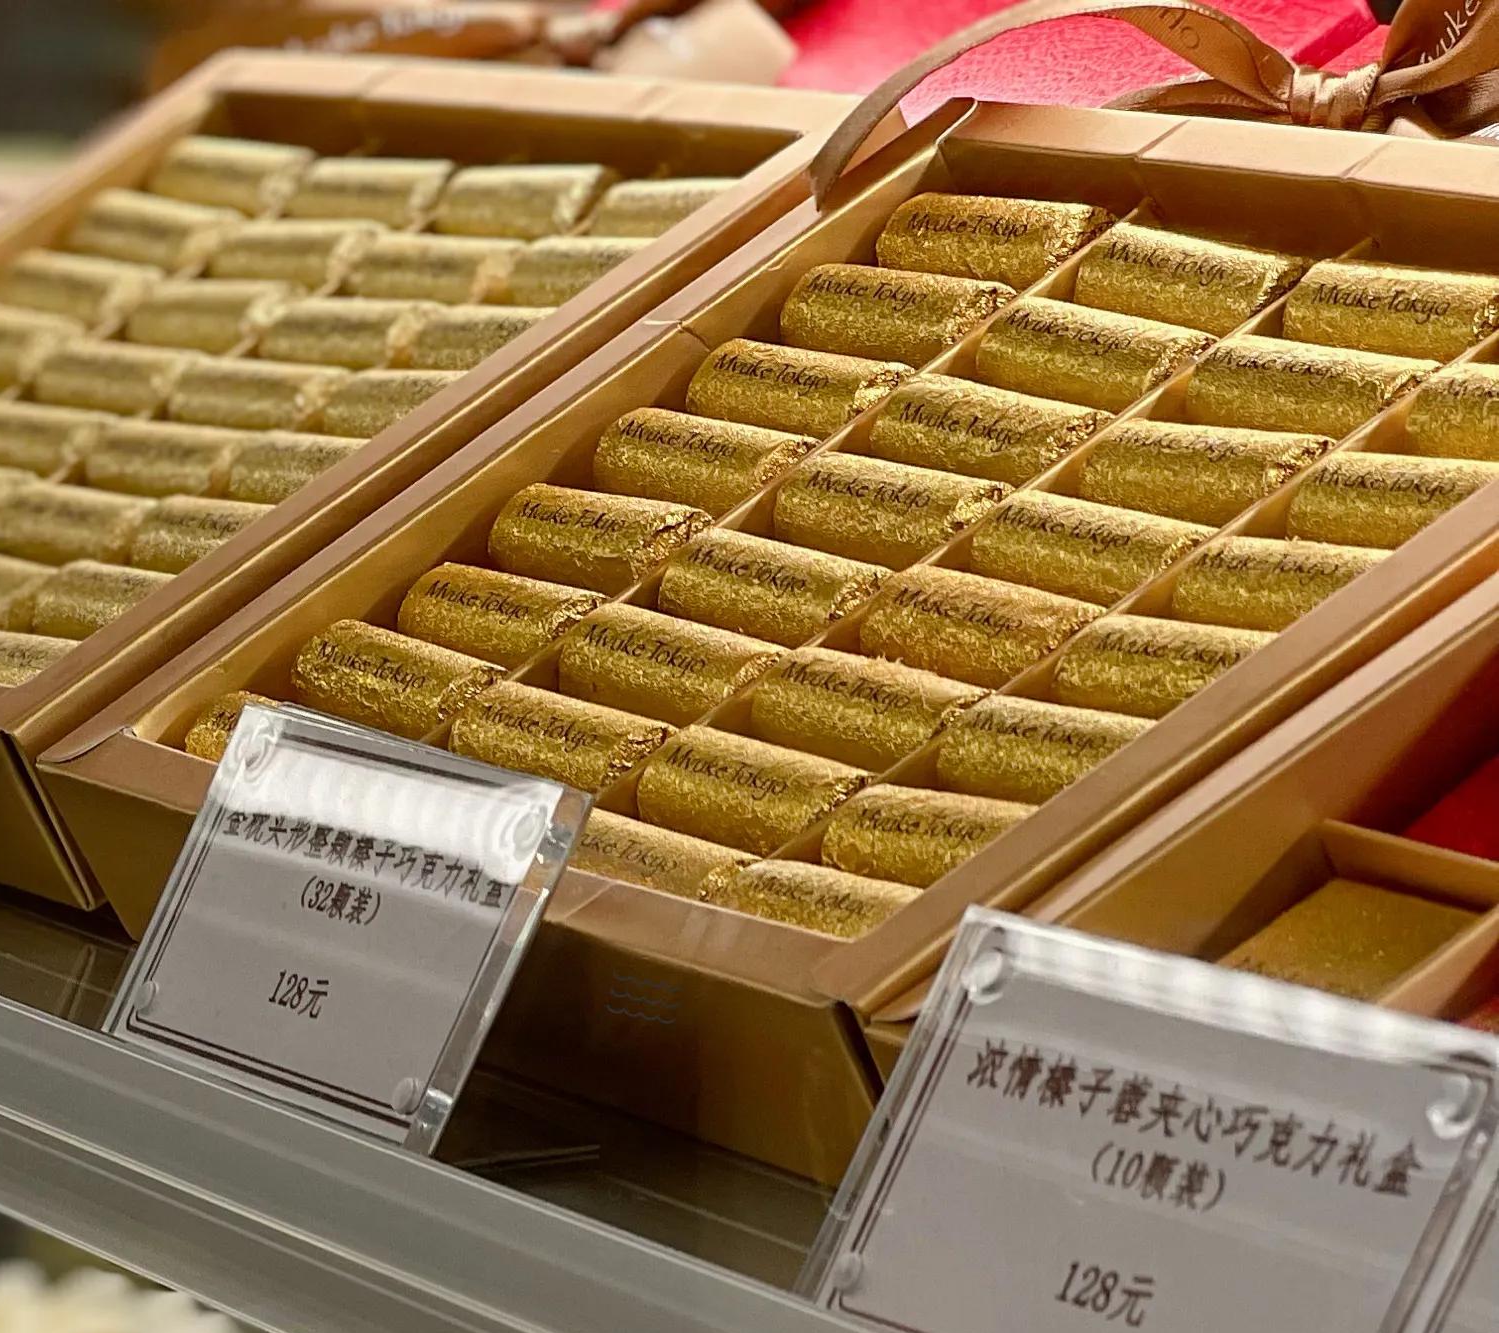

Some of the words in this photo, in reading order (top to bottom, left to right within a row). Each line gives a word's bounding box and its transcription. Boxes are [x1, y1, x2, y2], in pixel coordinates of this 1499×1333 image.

[300, 874, 381, 925] (32颗装)
[268, 969, 330, 1019] 128元
[1091, 1141, 1227, 1211] (10颗装)
[1055, 1261, 1156, 1328] 128元
